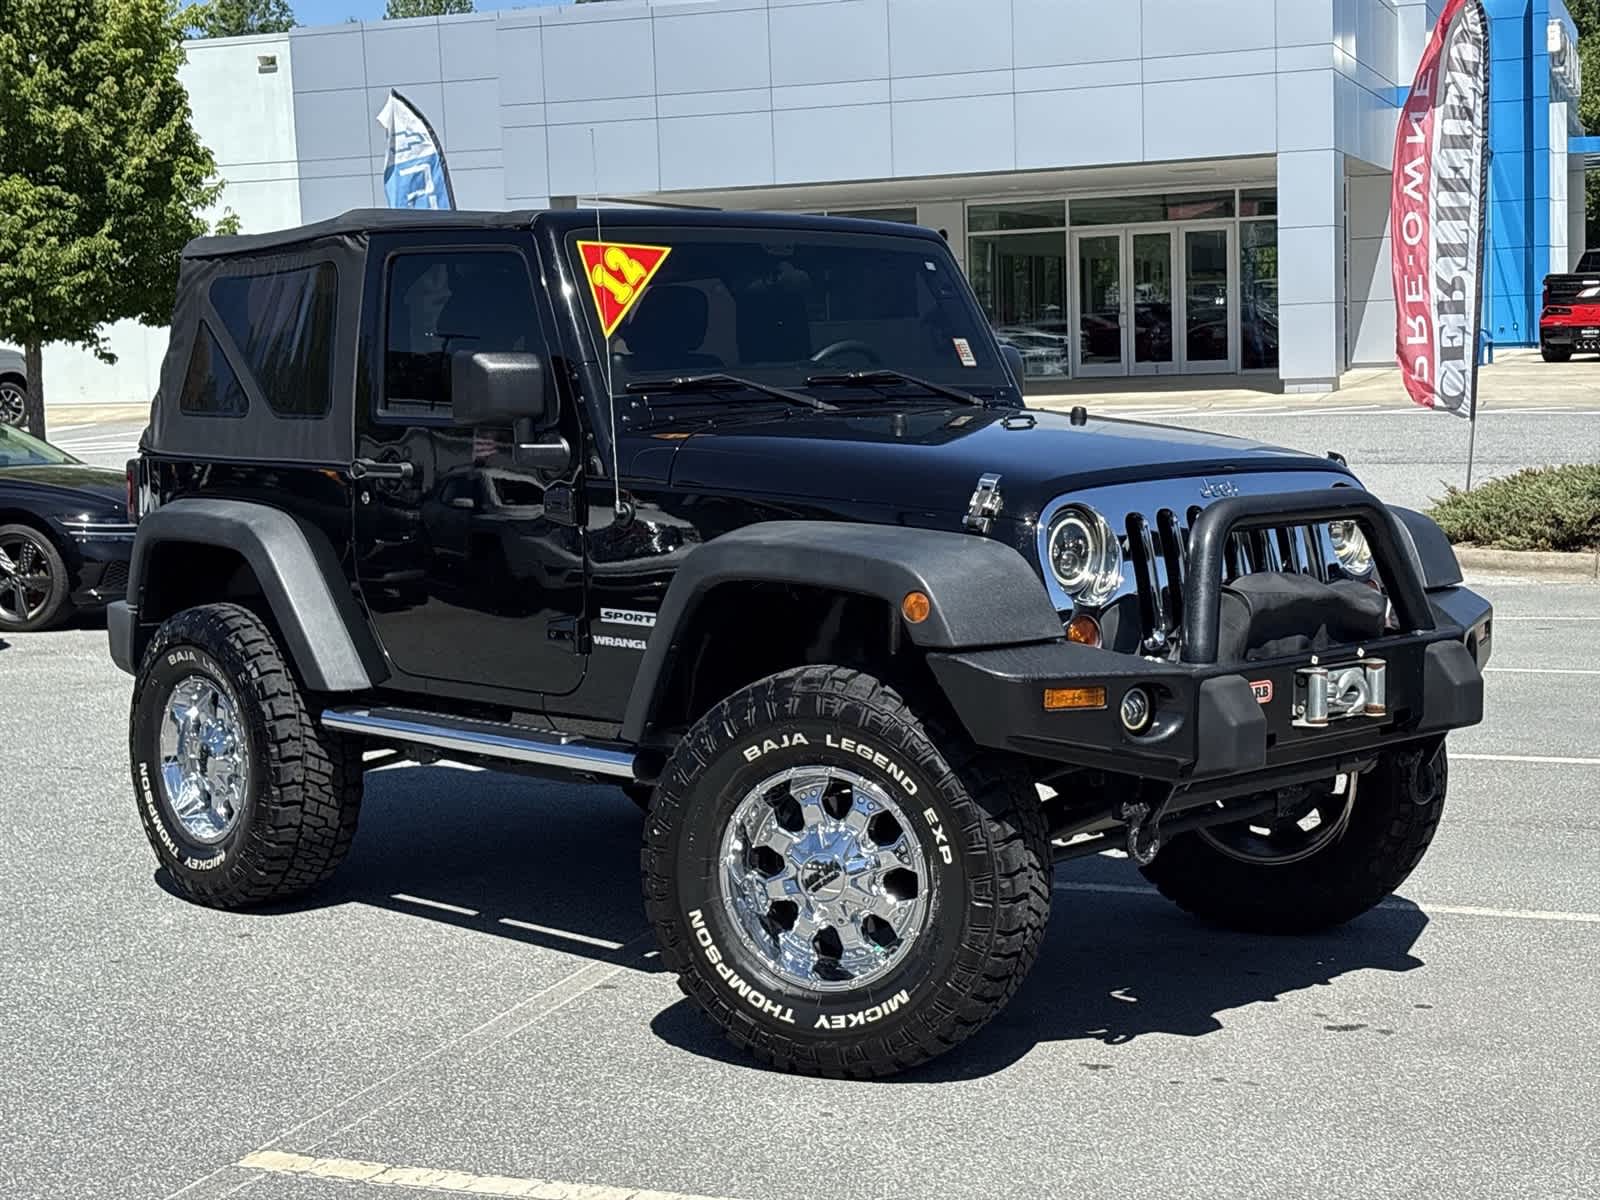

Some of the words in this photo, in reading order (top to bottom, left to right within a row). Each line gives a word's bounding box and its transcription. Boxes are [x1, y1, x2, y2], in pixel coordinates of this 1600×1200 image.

[592, 247, 647, 304] 12
[604, 611, 656, 624] SPORT
[168, 651, 196, 665] BAJA
[592, 635, 648, 650] WRANGL
[139, 763, 179, 859] THOMPSON
[743, 733, 809, 761] BAJA
[826, 734, 918, 796] LEGEND
[923, 807, 953, 864] EXP
[184, 851, 226, 870] MICKEY
[688, 909, 796, 1023] THOMPSON
[814, 990, 910, 1029] MICKEY
